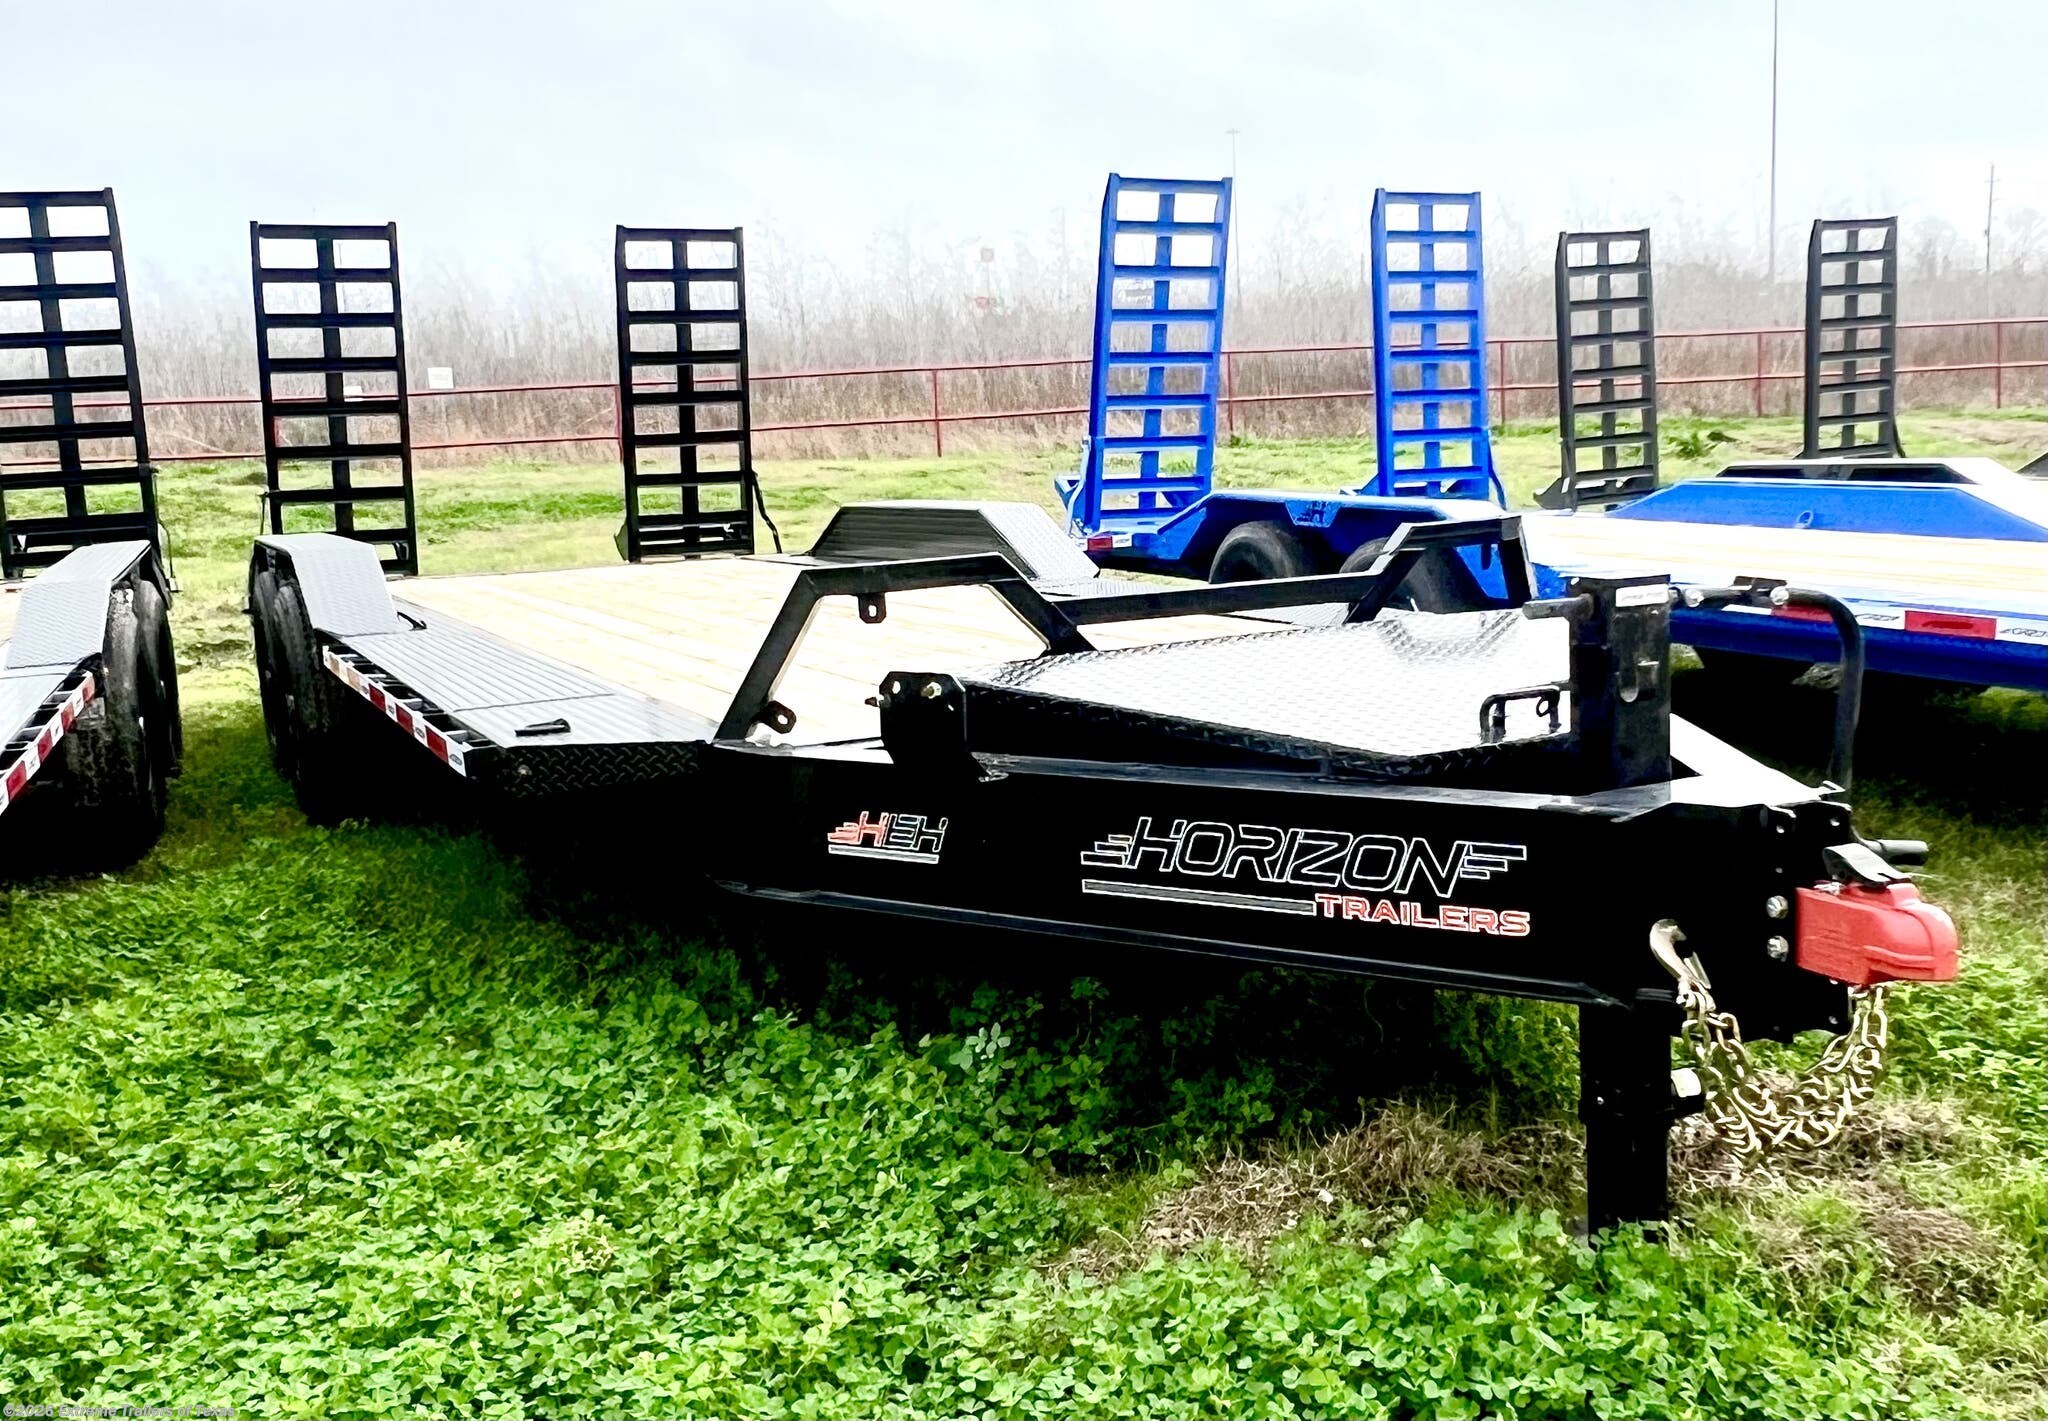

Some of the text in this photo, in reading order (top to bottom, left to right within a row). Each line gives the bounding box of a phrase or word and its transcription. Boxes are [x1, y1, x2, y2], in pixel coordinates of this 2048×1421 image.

[859, 811, 948, 852] HEH
[1126, 817, 1468, 898] HORIZON
[1315, 893, 1530, 936] TRAILERS
